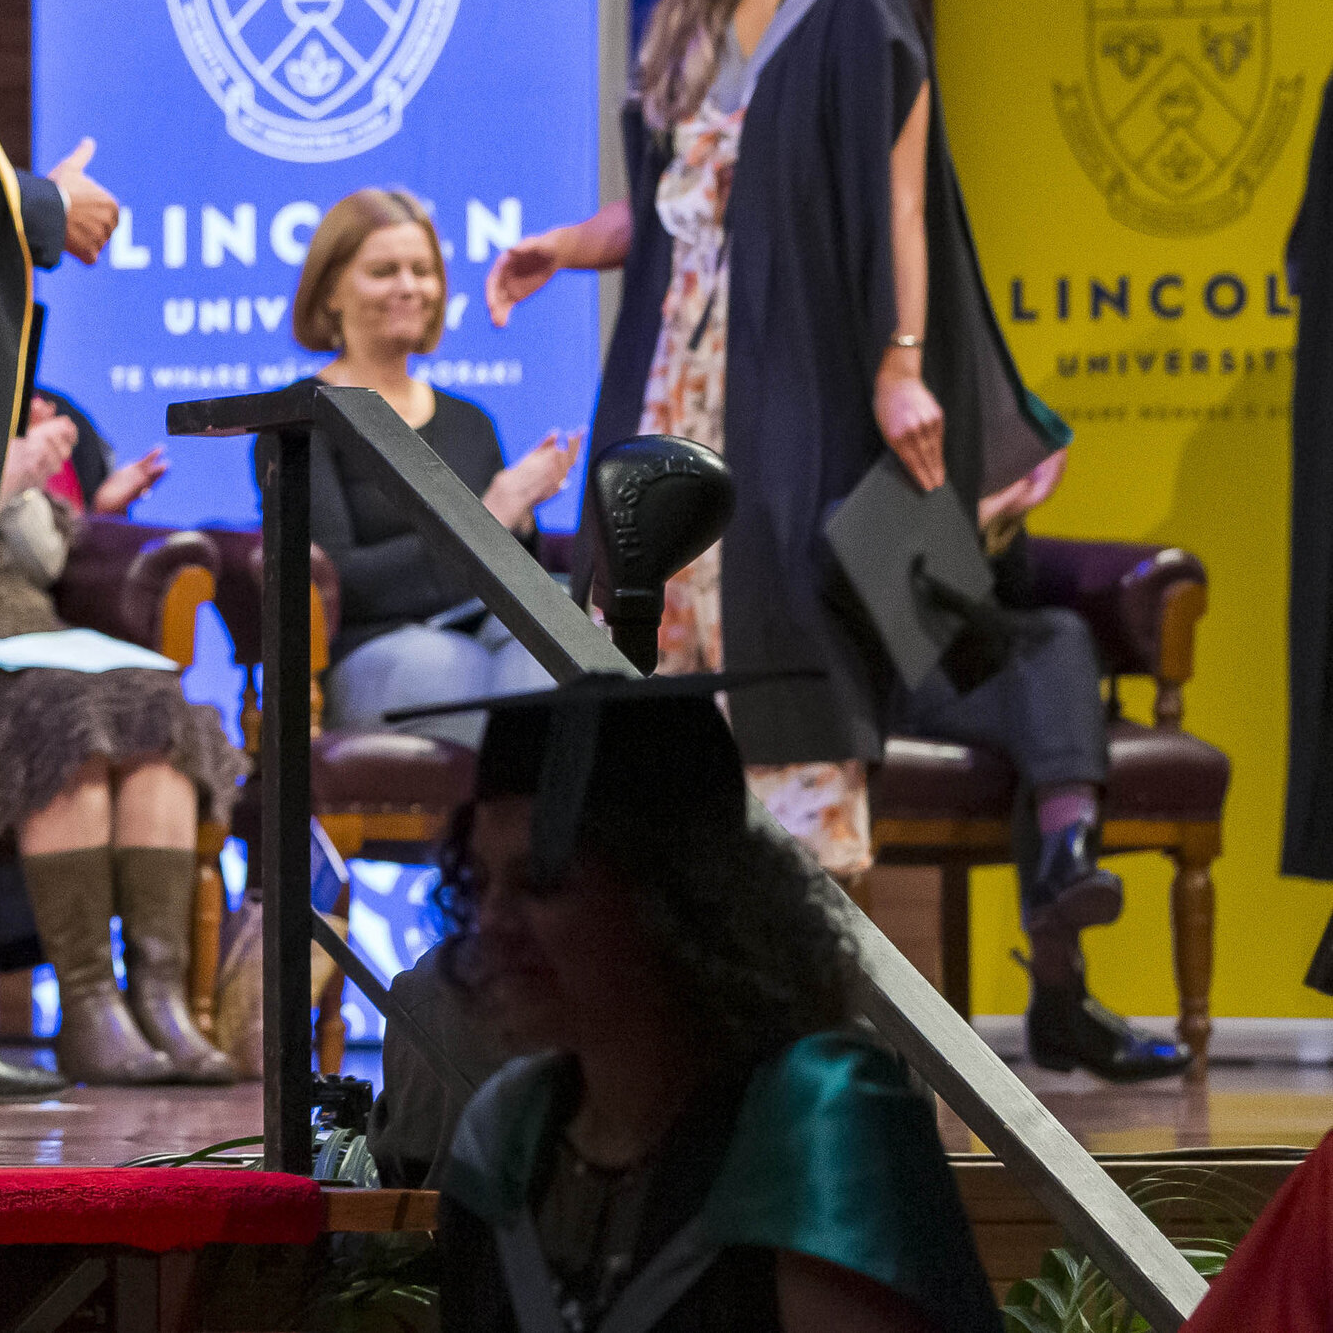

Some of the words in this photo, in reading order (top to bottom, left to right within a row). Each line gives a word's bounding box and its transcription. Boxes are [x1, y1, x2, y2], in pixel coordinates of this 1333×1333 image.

[109, 197, 523, 269] LINCN
[162, 293, 470, 335] UNIVY
[1010, 273, 1296, 323] LINCOL
